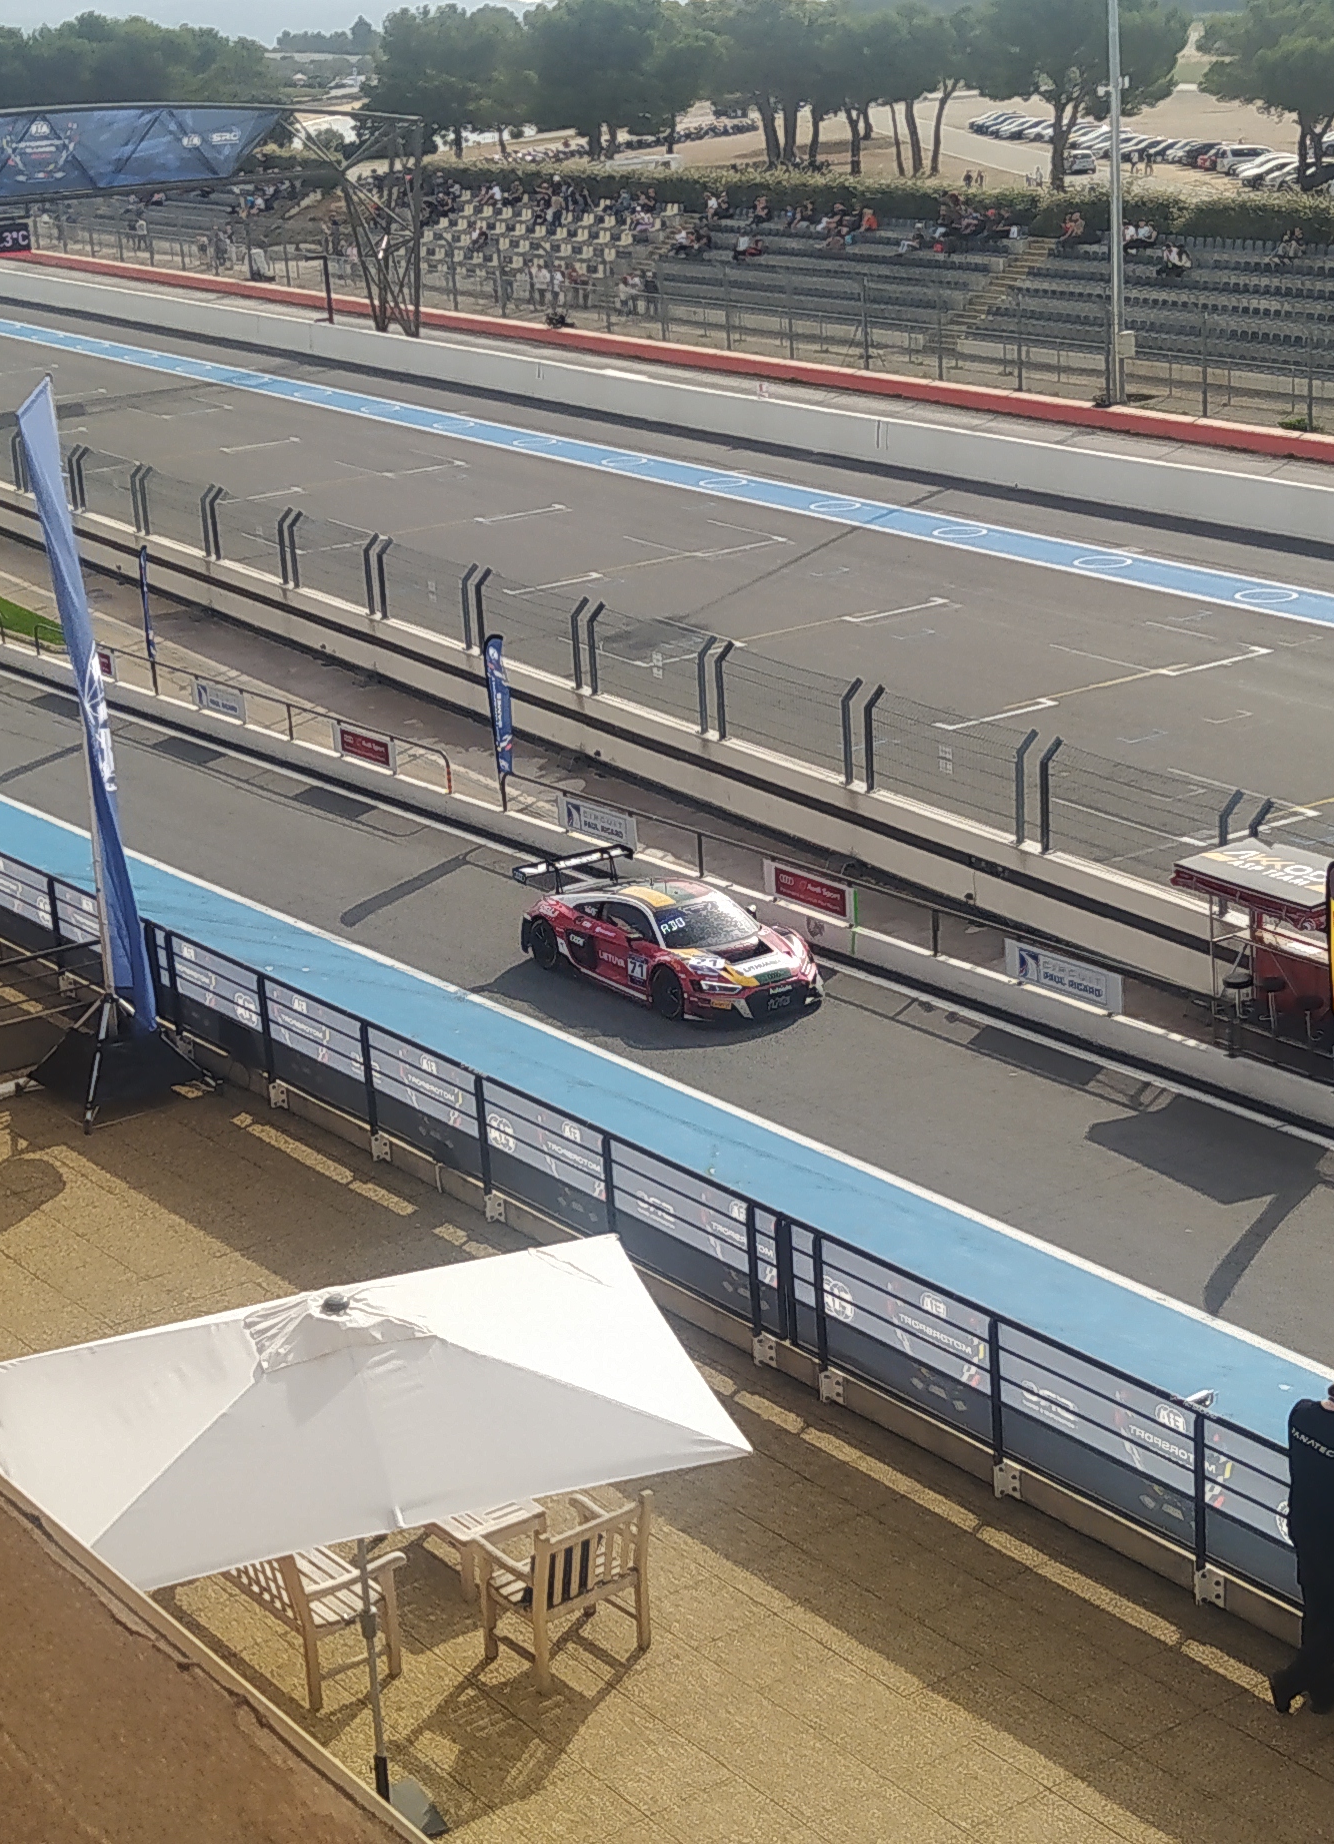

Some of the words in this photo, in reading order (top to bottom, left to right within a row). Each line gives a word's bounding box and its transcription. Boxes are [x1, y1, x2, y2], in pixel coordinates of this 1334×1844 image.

[1262, 869, 1310, 887] TEAM
[629, 960, 644, 978] 71
[1043, 971, 1067, 986] PAUL
[1068, 979, 1104, 998] RICARD
